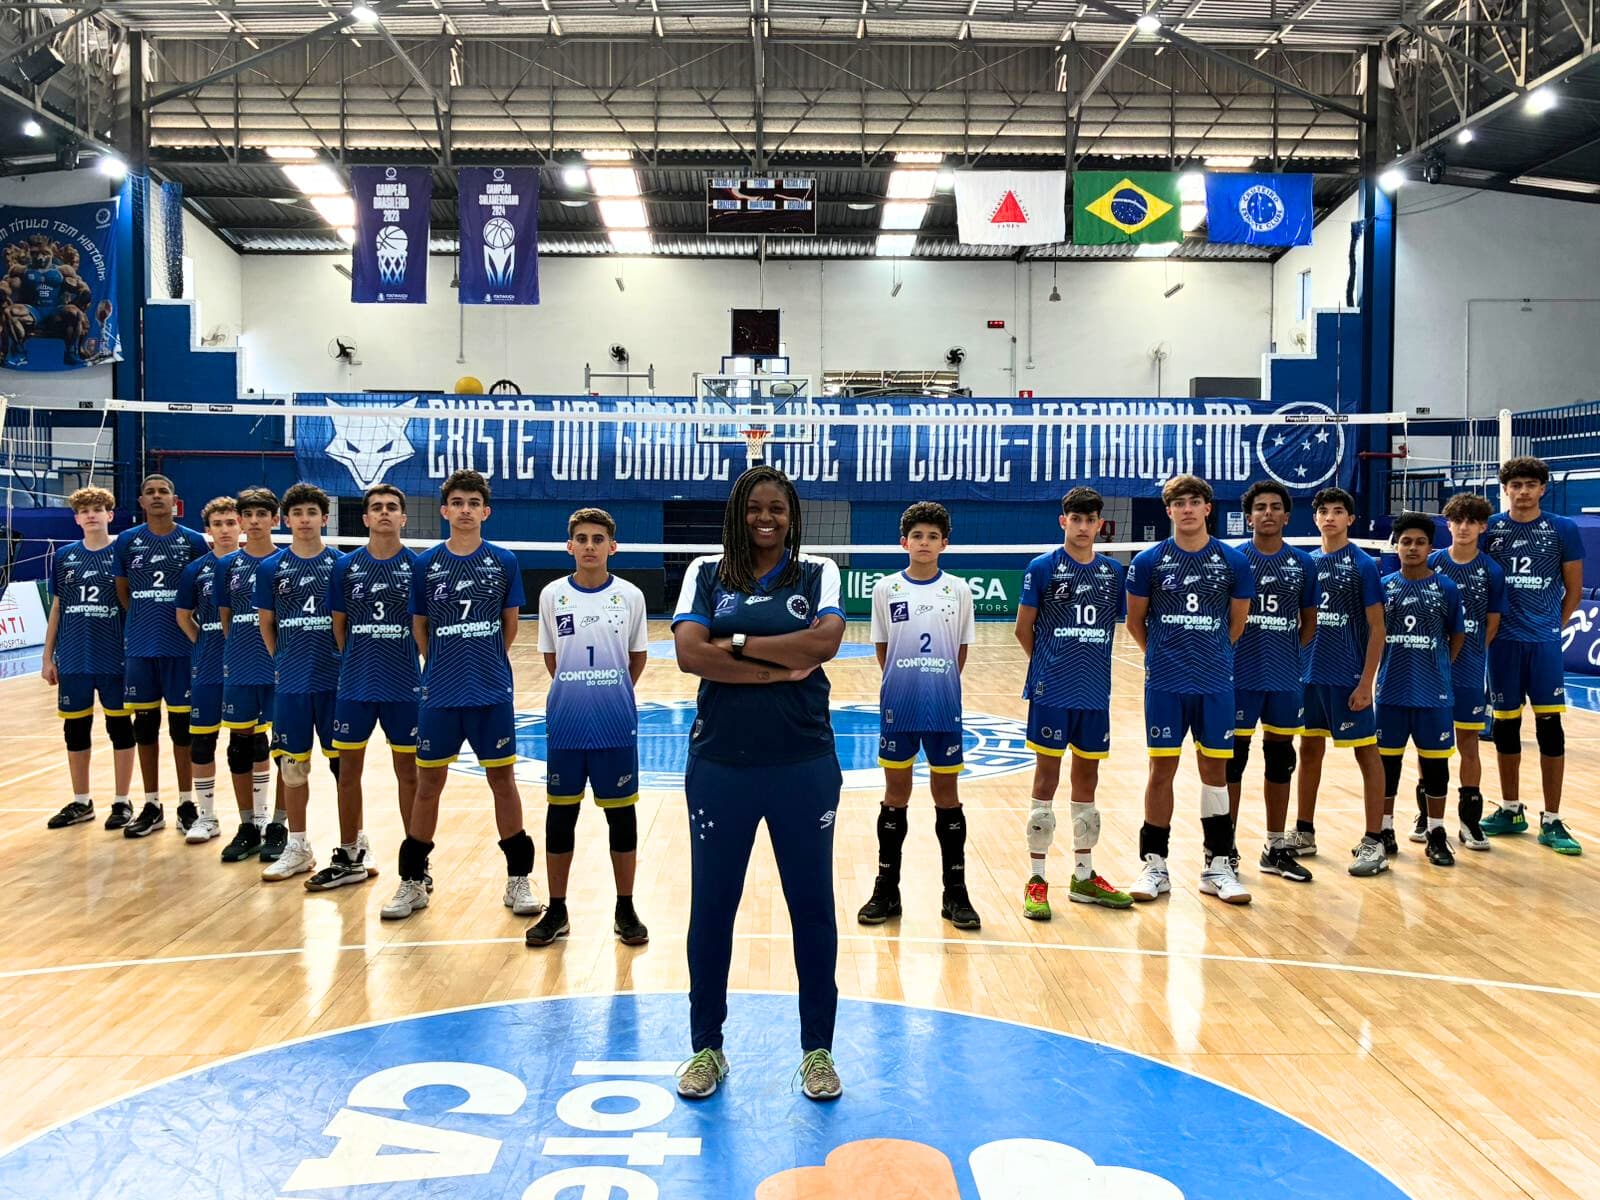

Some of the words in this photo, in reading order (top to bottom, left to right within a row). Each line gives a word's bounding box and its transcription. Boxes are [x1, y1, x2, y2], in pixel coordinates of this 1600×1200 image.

[427, 399, 536, 480] EXISTE
[552, 400, 600, 481] UM
[856, 403, 895, 482] NA
[1510, 556, 1532, 574] 12
[152, 571, 165, 588] 2
[79, 585, 100, 602] 12
[302, 596, 316, 614] 4
[372, 601, 385, 621] 3
[459, 599, 472, 620] 7
[973, 603, 1009, 612] OTORS
[1185, 592, 1199, 613] 8
[1258, 594, 1279, 613] 15
[279, 615, 333, 628] CONTORNO
[1073, 604, 1097, 625] 10
[1161, 614, 1213, 625] CONTORNO
[352, 624, 402, 634] CONTORNO
[436, 621, 491, 637] CONTORNO
[1403, 615, 1417, 632] 9
[1054, 627, 1106, 638] CONTORNO
[919, 632, 932, 653] 2
[586, 646, 594, 667] 1
[896, 657, 946, 668] CONTORNO
[559, 668, 618, 682] CONTORNO
